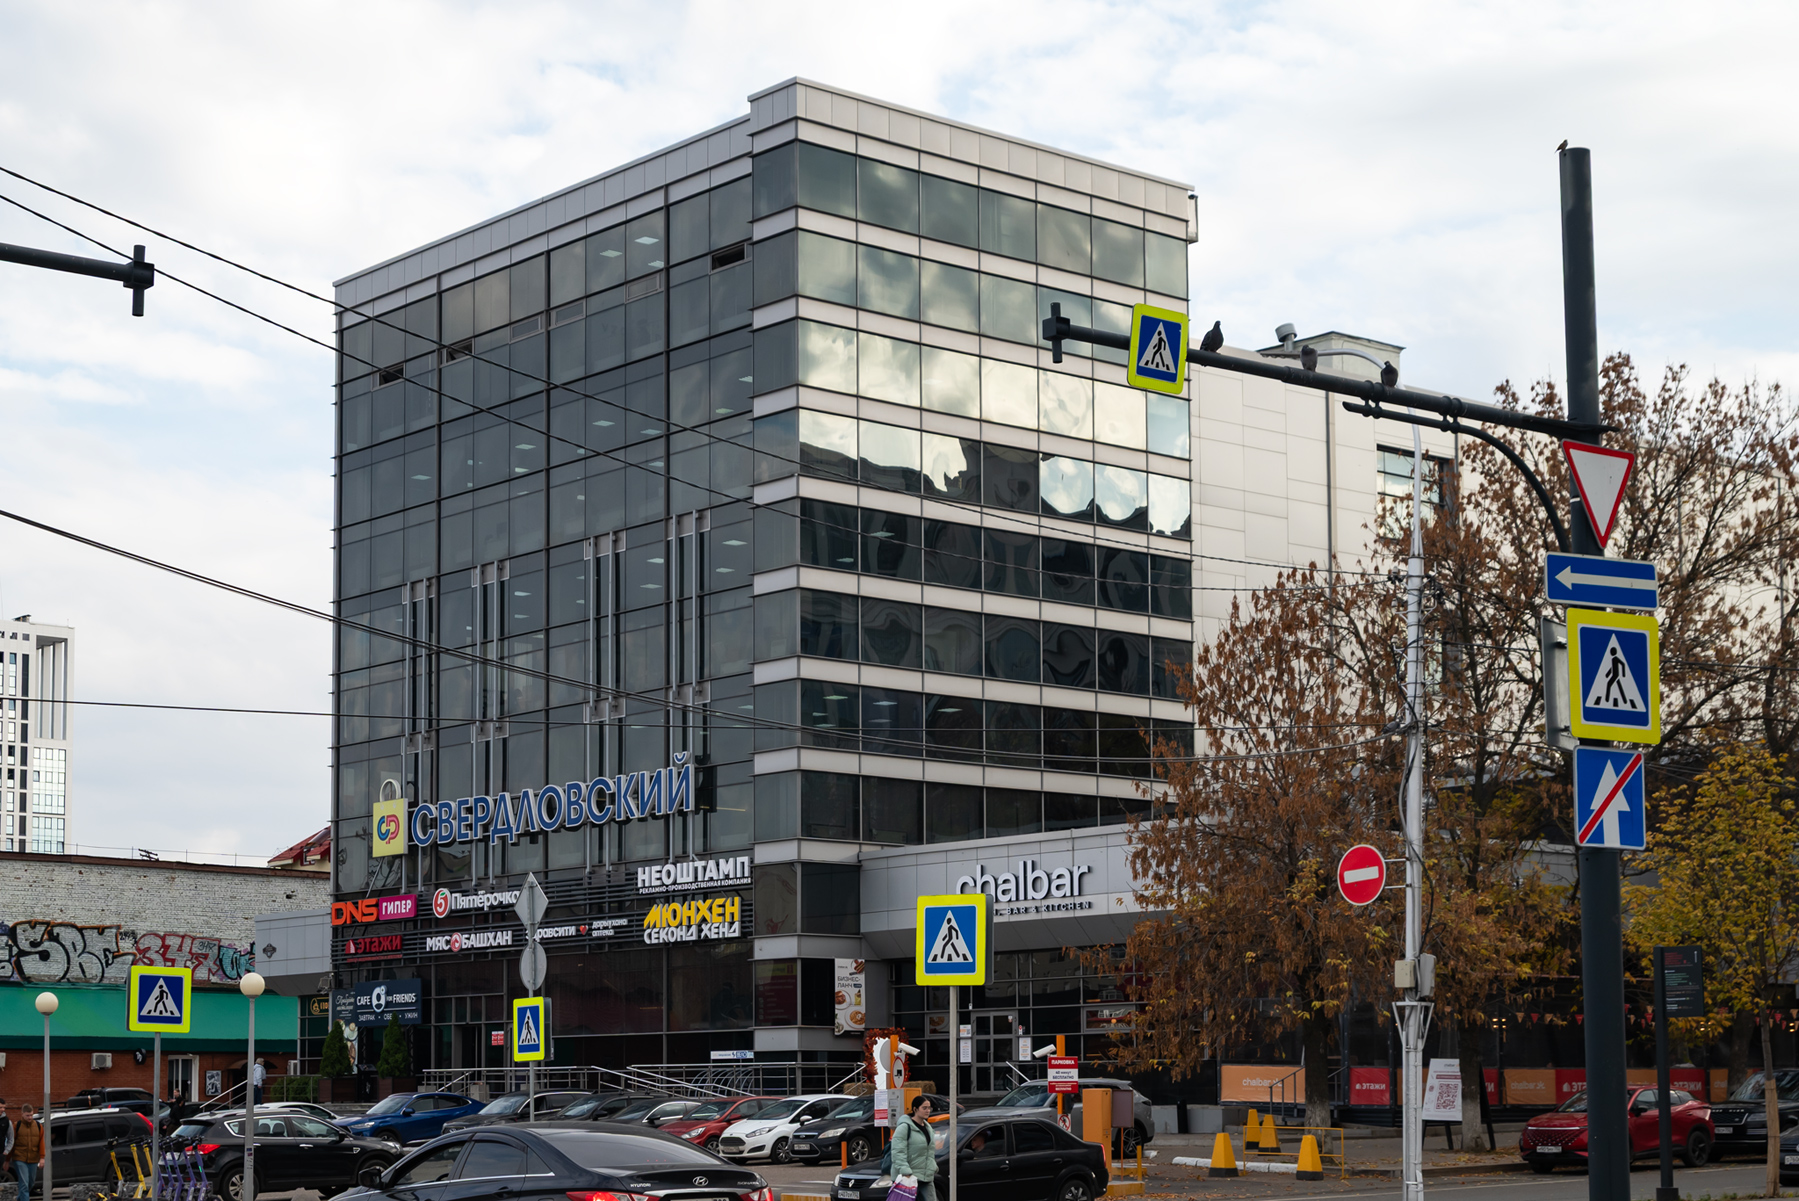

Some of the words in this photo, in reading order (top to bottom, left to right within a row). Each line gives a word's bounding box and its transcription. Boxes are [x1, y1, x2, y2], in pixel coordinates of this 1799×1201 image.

[411, 751, 695, 847] СВЕРДЛОВСКИЙ
[638, 856, 750, 887] НЕОШТАМП
[956, 859, 1091, 903] chalbar
[639, 880, 721, 894] РЕКЛАМНО-ПРОИЗВОДСТВЕННАЯ
[721, 877, 751, 887] КОМПАНИЯ
[331, 898, 379, 926] DNS
[382, 899, 412, 915] ГИПЕР
[643, 897, 741, 929] МЮНХЕН
[1006, 906, 1027, 915] BAR
[1043, 901, 1092, 912] KITCHEN
[644, 924, 698, 944] СЕКОНД
[701, 921, 740, 939] ХЕНД
[357, 996, 370, 1005] CAFE
[393, 993, 416, 1003] FRIENDS
[1242, 1077, 1271, 1087] chalbar
